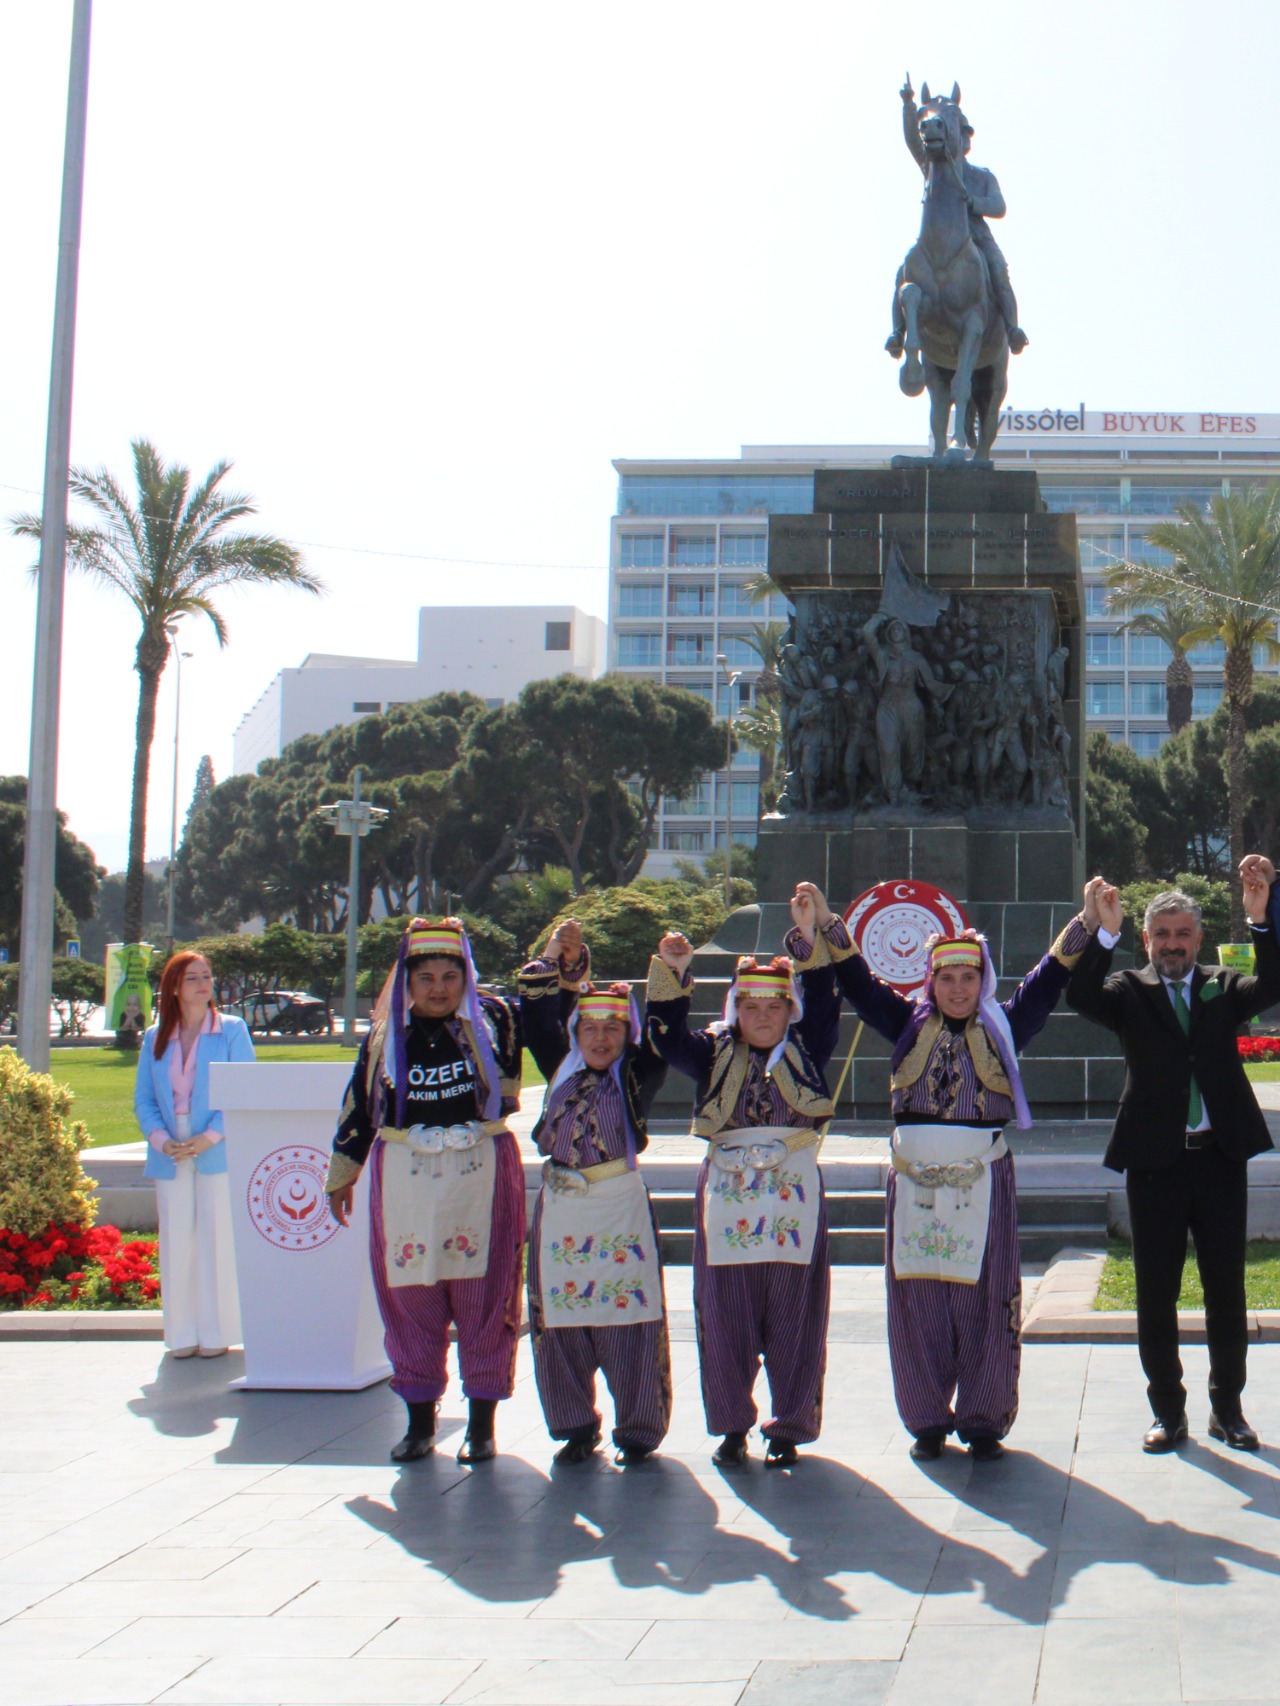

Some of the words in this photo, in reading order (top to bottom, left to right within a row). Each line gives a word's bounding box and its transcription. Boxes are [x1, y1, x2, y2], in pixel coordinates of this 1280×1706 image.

[976, 402, 1085, 431] issôtel
[1102, 412, 1185, 432] BÜYÜK
[1200, 413, 1257, 433] EFES
[407, 1090, 438, 1101] AKIM
[441, 1082, 476, 1099] MERK
